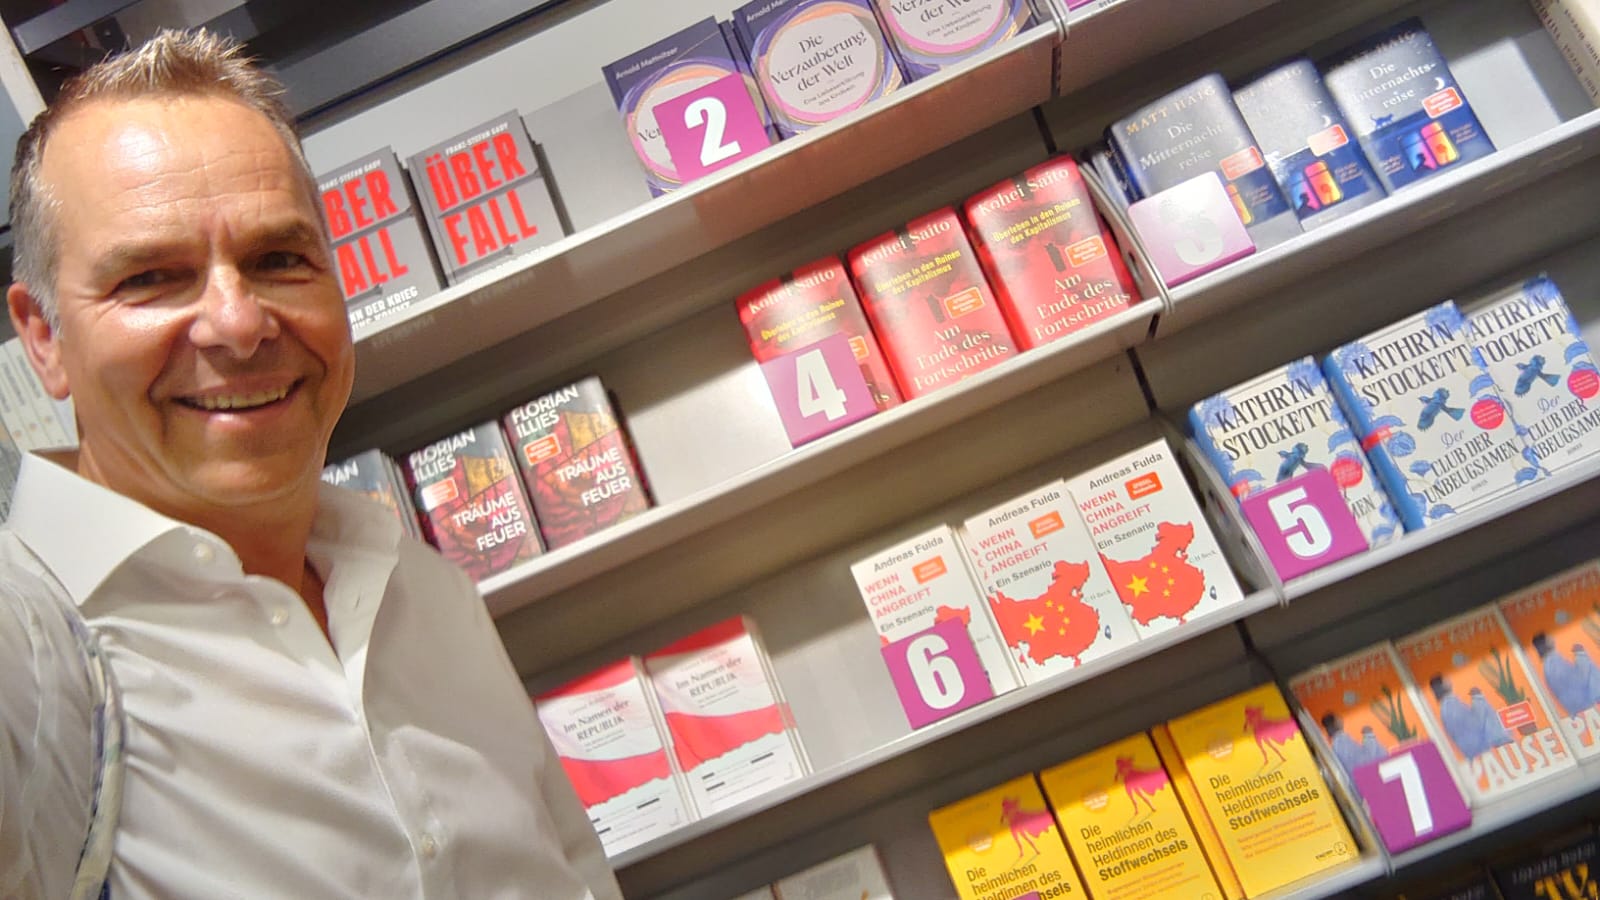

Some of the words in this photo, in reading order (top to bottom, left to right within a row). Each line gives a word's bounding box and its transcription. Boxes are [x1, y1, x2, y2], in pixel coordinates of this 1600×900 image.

[920, 4, 944, 23] der
[771, 30, 867, 85] Verzauberung
[799, 35, 823, 53] Die
[797, 72, 820, 91] der
[821, 55, 854, 76] Welt
[1369, 63, 1395, 79] Die
[1382, 88, 1416, 108] reise
[684, 97, 742, 168] 2
[1126, 106, 1170, 136] MATT
[1167, 121, 1193, 139] Die
[425, 131, 526, 212] ÜBER
[1177, 149, 1211, 171] reise
[321, 169, 398, 239] BER
[978, 186, 1025, 216] Kohei
[1027, 168, 1070, 193] Saito
[443, 189, 538, 266] FALL
[861, 238, 907, 267] Kohei
[909, 219, 951, 245] Saito
[1159, 200, 1224, 266] 3
[336, 228, 408, 298] ALL
[794, 269, 835, 288] Saito
[1054, 273, 1081, 293] Am
[365, 301, 386, 318] DER
[387, 286, 418, 310] KRIEG
[1034, 293, 1130, 340] Fortschritts
[1036, 293, 1079, 320] Ende
[1084, 280, 1113, 299] des
[934, 324, 961, 344] Am
[1469, 295, 1550, 341] ATHRYN
[916, 342, 957, 369] Ende
[962, 331, 990, 351] des
[1353, 320, 1454, 380] KATHRYN
[1474, 312, 1566, 367] TOCKETT
[913, 344, 1008, 390] Fortschritts
[1361, 343, 1472, 408] STOCKETT
[795, 348, 847, 421] 4
[510, 385, 578, 425] FLORIAN
[1215, 376, 1315, 435] KATHRYN
[1528, 412, 1563, 441] CLUB
[1560, 398, 1588, 422] DER
[1537, 395, 1560, 414] Der
[516, 410, 560, 439] ILLIES
[1223, 399, 1331, 461] STOCKETT
[1441, 429, 1465, 449] Der
[409, 429, 475, 468] FLORIAN
[556, 447, 622, 483] TRÄUME
[1431, 447, 1467, 477] CLUB
[1465, 432, 1494, 457] DER
[413, 456, 456, 483] ILLIES
[596, 465, 626, 485] AUS
[1089, 465, 1132, 491] Andreas
[1132, 452, 1163, 472] Fulda
[1423, 439, 1520, 503] UNBEUGSAMEN
[581, 477, 631, 506] FEUER
[1080, 489, 1117, 513] WENN
[452, 491, 516, 528] TRÄUME
[491, 509, 521, 530] AUS
[988, 503, 1031, 528] Andreas
[1031, 490, 1061, 510] Fulda
[1086, 502, 1124, 525] CHINA
[1092, 504, 1152, 537] ANGREIFT
[1268, 486, 1332, 558] 5
[476, 521, 526, 551] FEUER
[979, 528, 1016, 549] WENN
[985, 540, 1022, 563] CHINA
[1098, 536, 1114, 550] Ein
[1114, 520, 1155, 545] Szenario
[873, 548, 914, 573] Andreas
[914, 535, 944, 553] Fulda
[991, 543, 1049, 575] ANGREIFT
[864, 573, 900, 595] WENN
[996, 574, 1012, 589] Ein
[1012, 559, 1052, 583] Szenario
[870, 585, 907, 606] CHINA
[875, 587, 932, 619] ANGREIFT
[880, 619, 896, 632] Ein
[896, 604, 935, 627] Szenario
[689, 672, 738, 698] REPUBLIK
[690, 662, 725, 683] Namen
[726, 656, 742, 669] der
[906, 634, 965, 710] 6
[576, 715, 625, 741] REPUBLIK
[577, 705, 612, 726] Namen
[613, 699, 629, 713] der
[1209, 774, 1231, 790] Die
[1215, 770, 1284, 803] heimlichen
[1222, 786, 1286, 817] Heldinnen
[1285, 776, 1309, 793] des
[1379, 752, 1434, 838] 7
[1229, 788, 1320, 831] Stoffwechsels
[1080, 824, 1102, 840] Die
[1086, 821, 1153, 854] heimlichen
[1092, 836, 1155, 868] Heldinnen
[1155, 827, 1178, 844] des
[966, 866, 987, 882] Die
[1098, 839, 1189, 881] Stoffwechsels
[971, 863, 1038, 896] heimlichen
[1038, 870, 1062, 886] des
